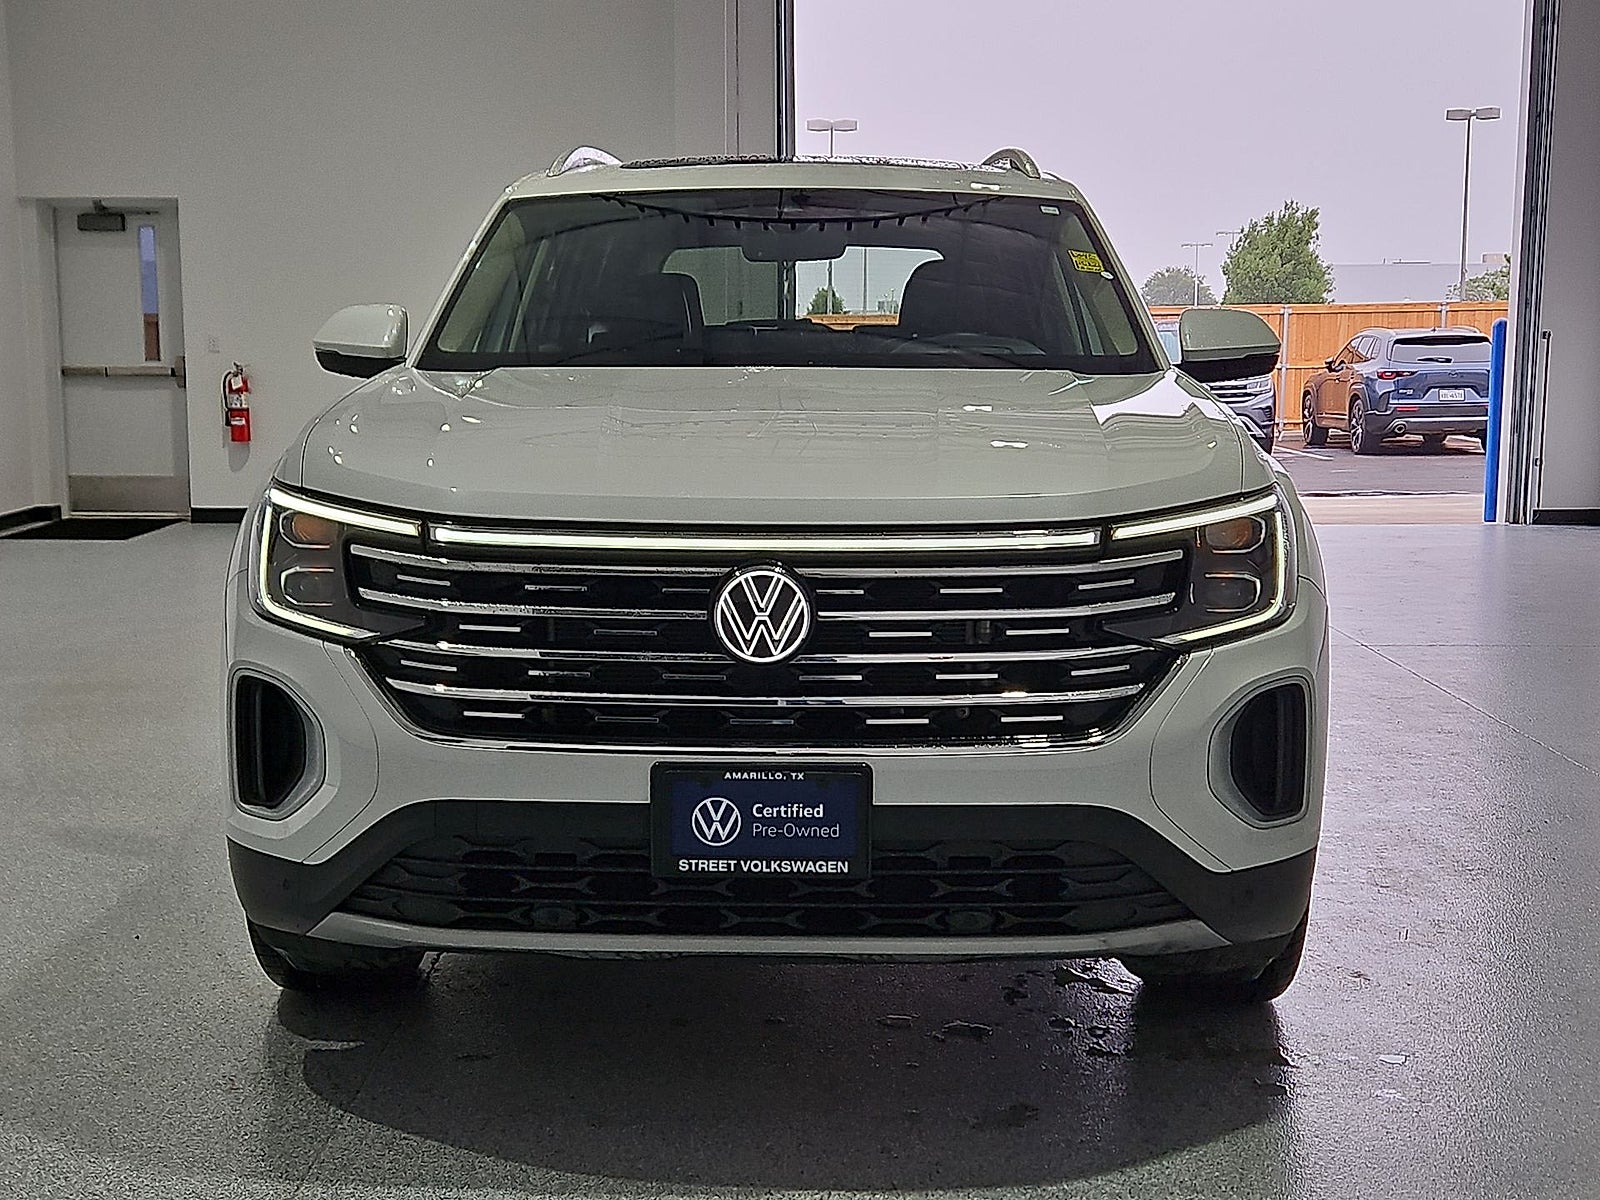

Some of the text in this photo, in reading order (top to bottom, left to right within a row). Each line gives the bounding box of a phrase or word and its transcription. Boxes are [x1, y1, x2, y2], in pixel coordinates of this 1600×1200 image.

[724, 772, 804, 780] AMARILLO, TX
[752, 803, 824, 818] Certified
[752, 823, 840, 838] Pre-Owned
[678, 859, 849, 874] STREET VOLKSWAGEN
